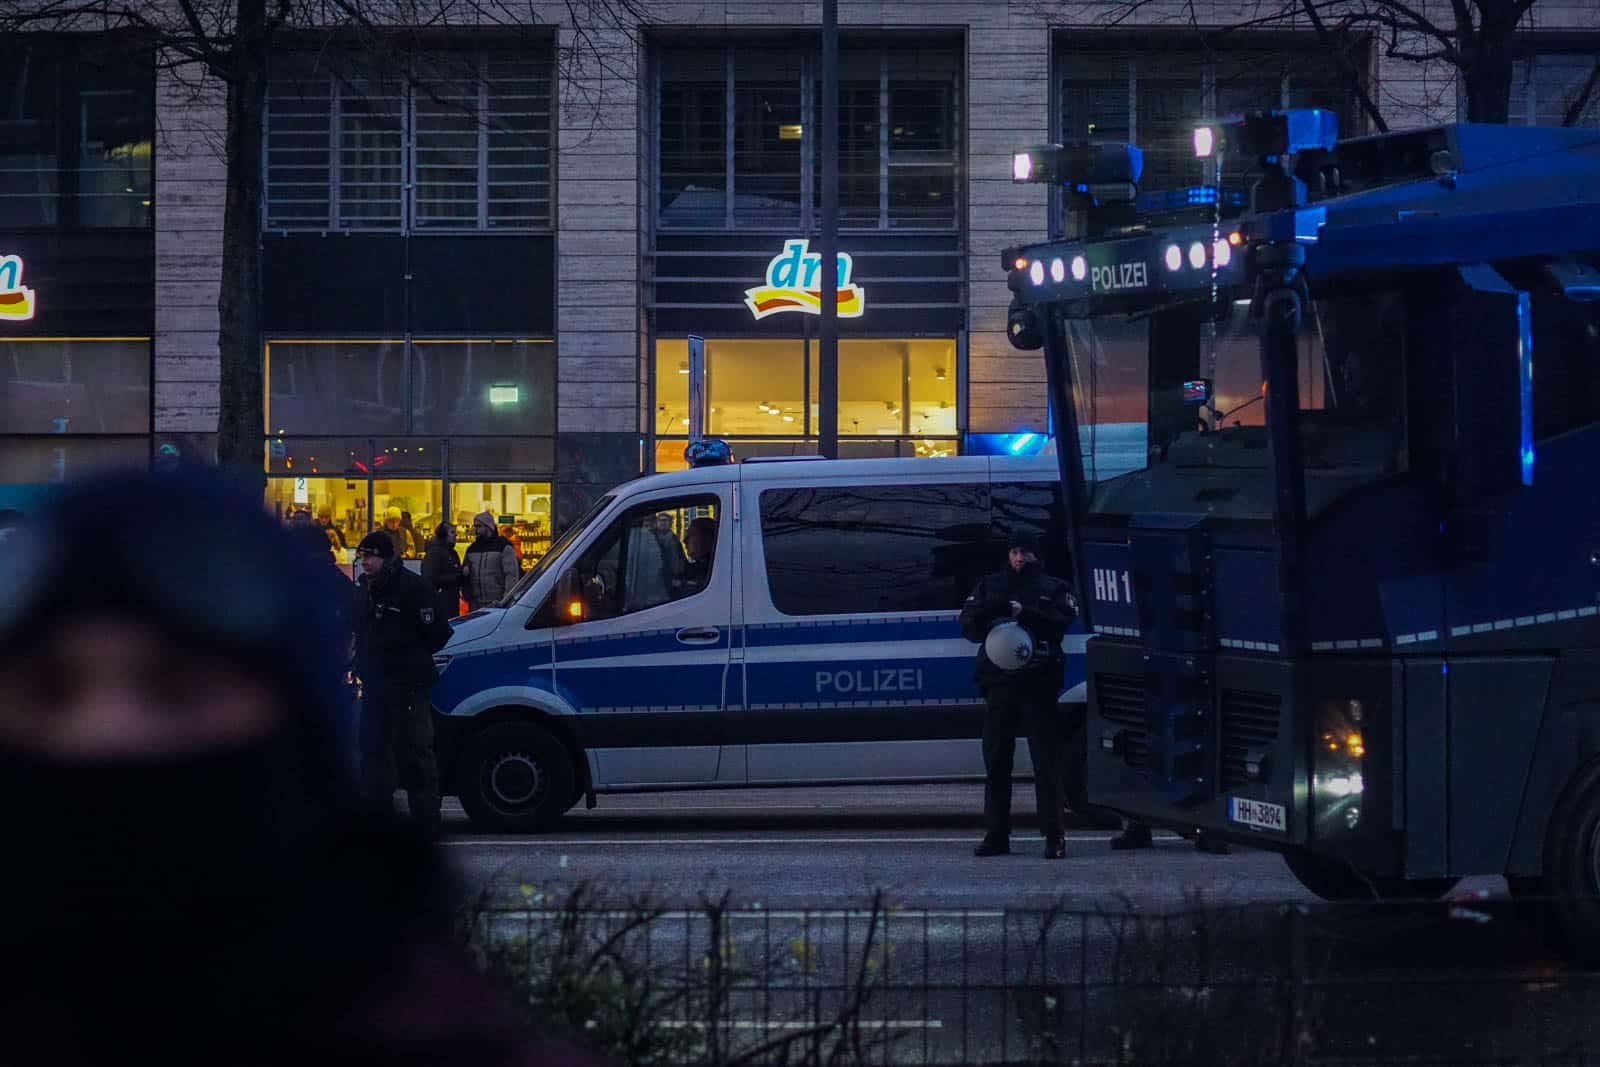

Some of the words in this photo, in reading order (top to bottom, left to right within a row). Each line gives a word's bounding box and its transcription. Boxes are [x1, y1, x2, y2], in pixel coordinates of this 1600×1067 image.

[1091, 261, 1148, 290] POLIZEI
[1094, 568, 1118, 602] HH
[1121, 570, 1131, 603] 1
[815, 669, 923, 693] POLIZEI
[1257, 803, 1281, 827] 3894
